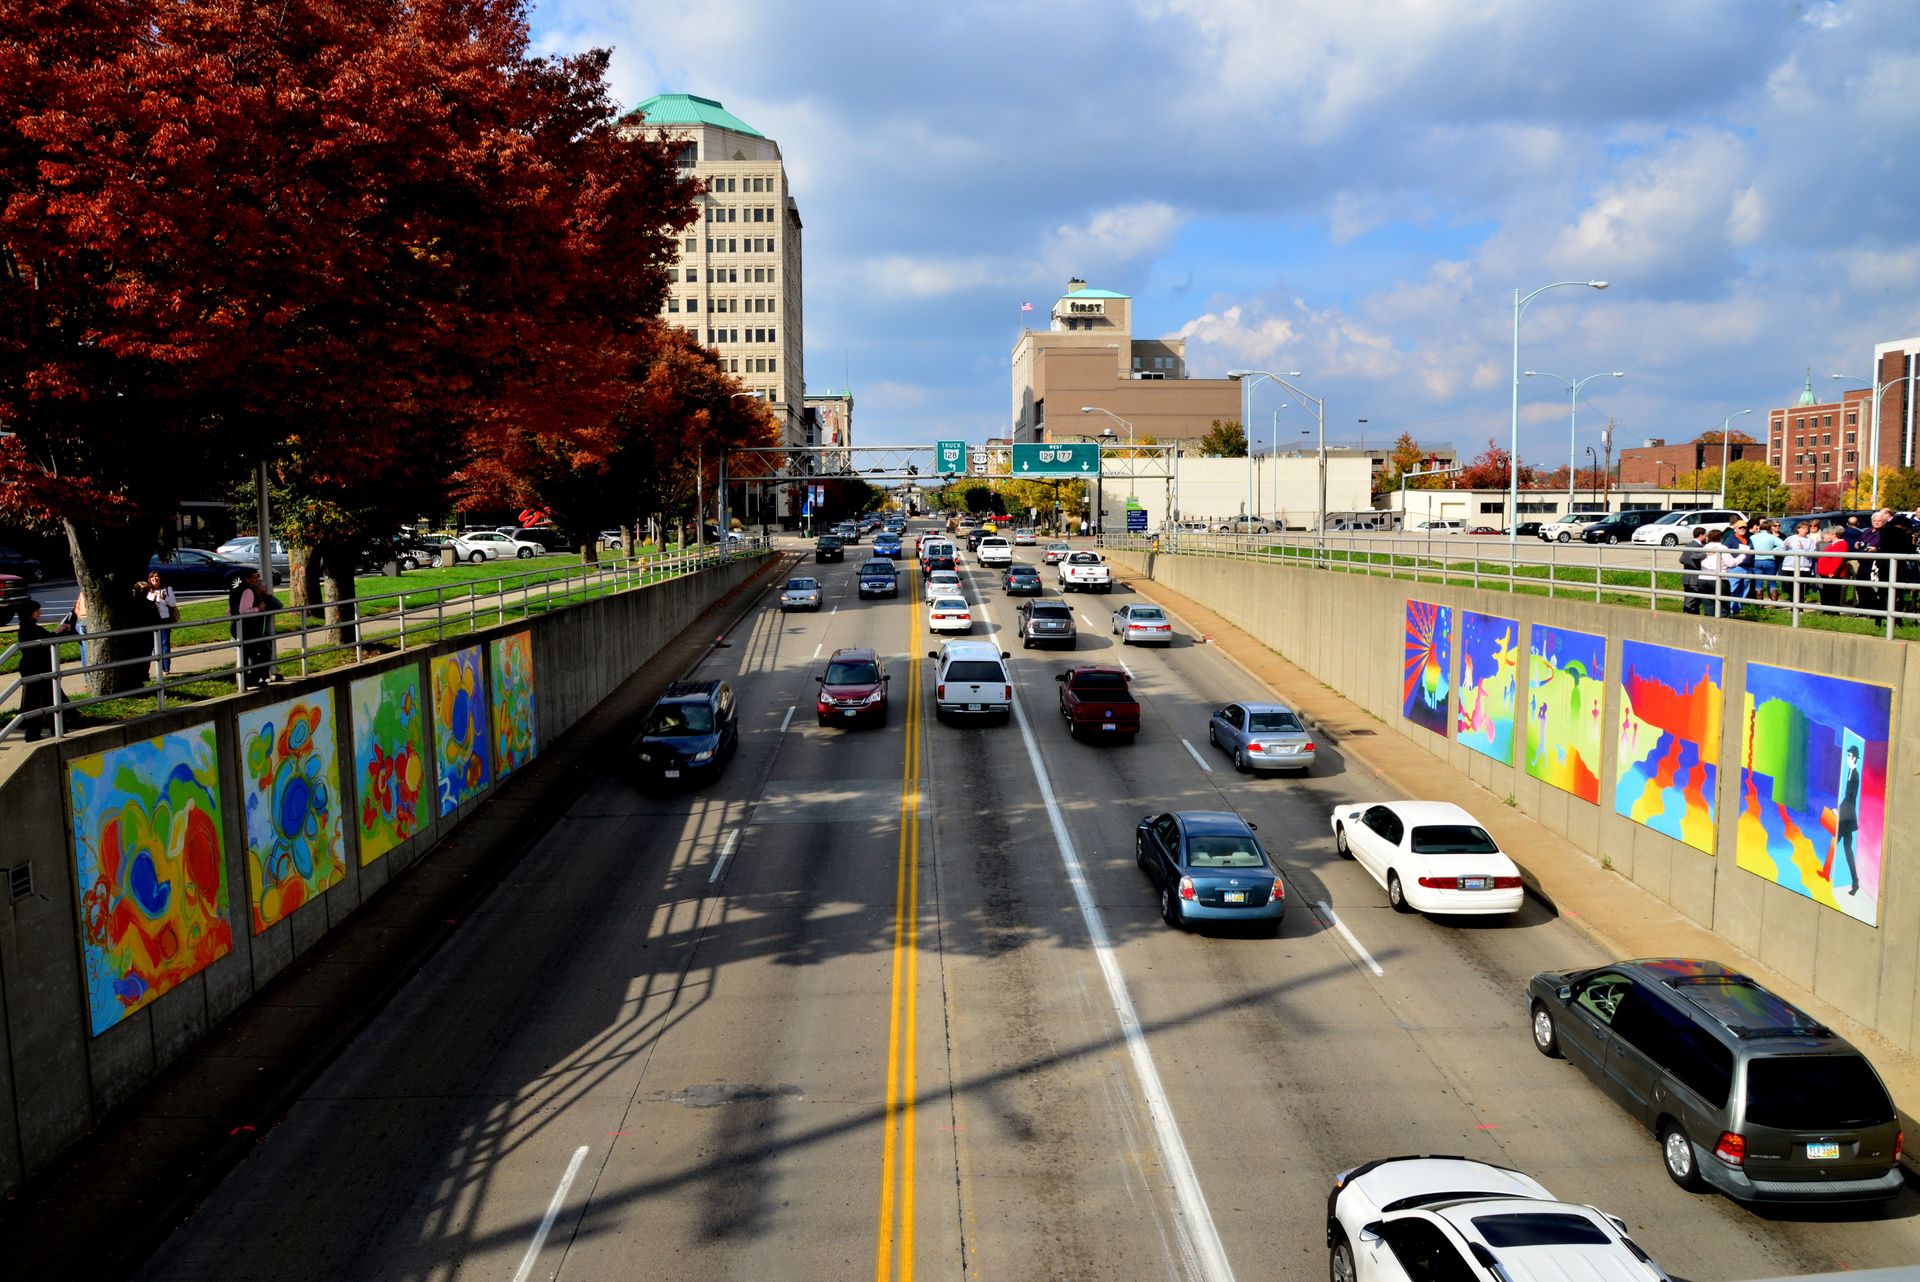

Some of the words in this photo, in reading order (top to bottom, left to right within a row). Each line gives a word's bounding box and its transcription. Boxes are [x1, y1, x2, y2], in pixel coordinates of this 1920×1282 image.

[944, 451, 958, 459] 128
[974, 454, 986, 462] 127
[1040, 452, 1053, 460] 129
[1058, 452, 1071, 460] 177
